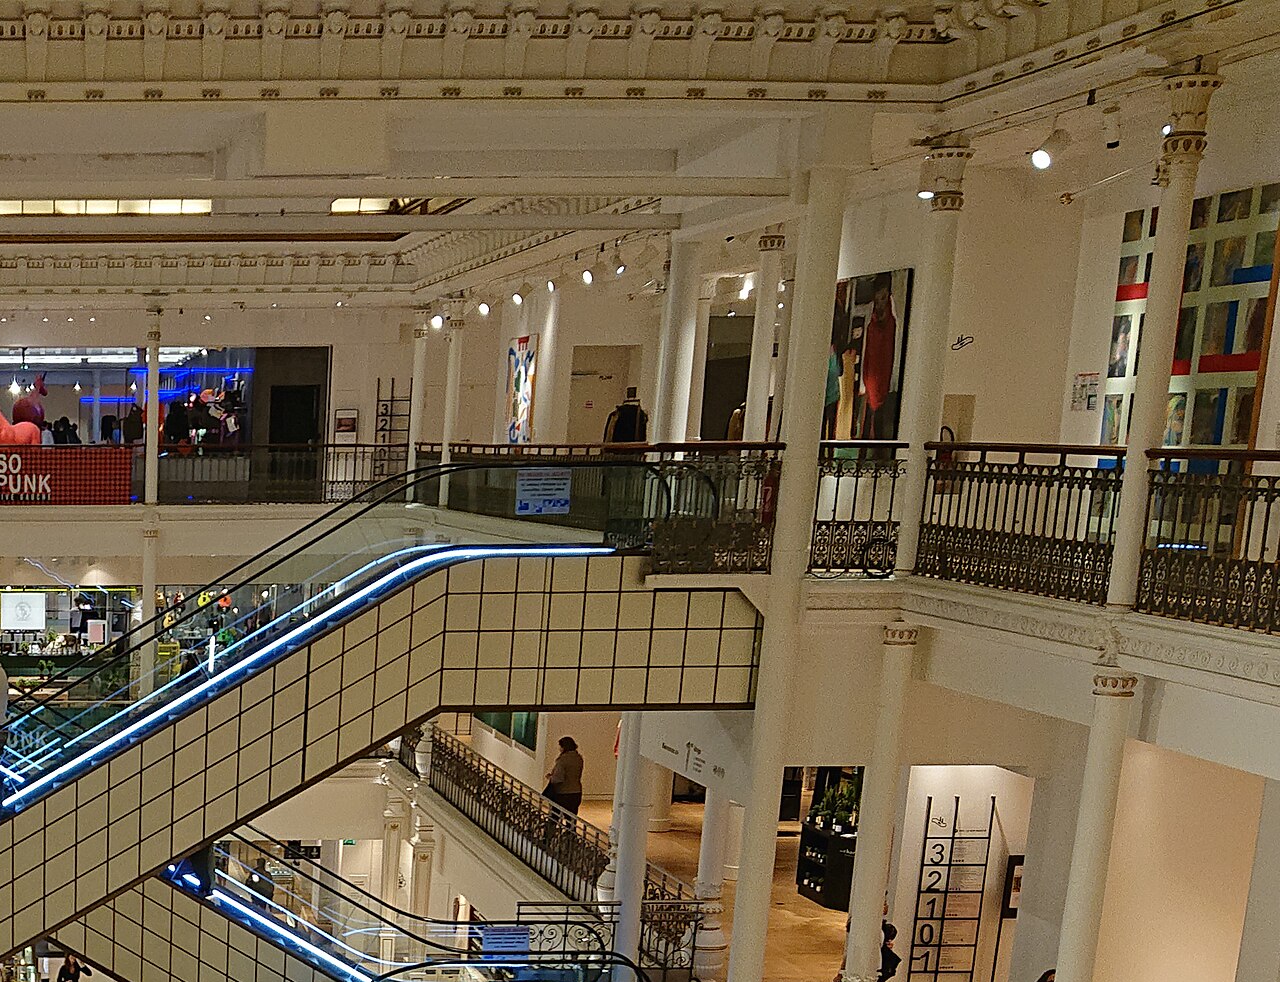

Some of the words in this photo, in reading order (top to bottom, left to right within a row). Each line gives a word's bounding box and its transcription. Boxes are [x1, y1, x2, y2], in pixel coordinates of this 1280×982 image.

[381, 403, 389, 416] 3
[380, 418, 388, 431] 2
[930, 843, 945, 865] 3
[926, 870, 942, 892] 2
[926, 898, 937, 918] 1
[919, 923, 934, 945] 0
